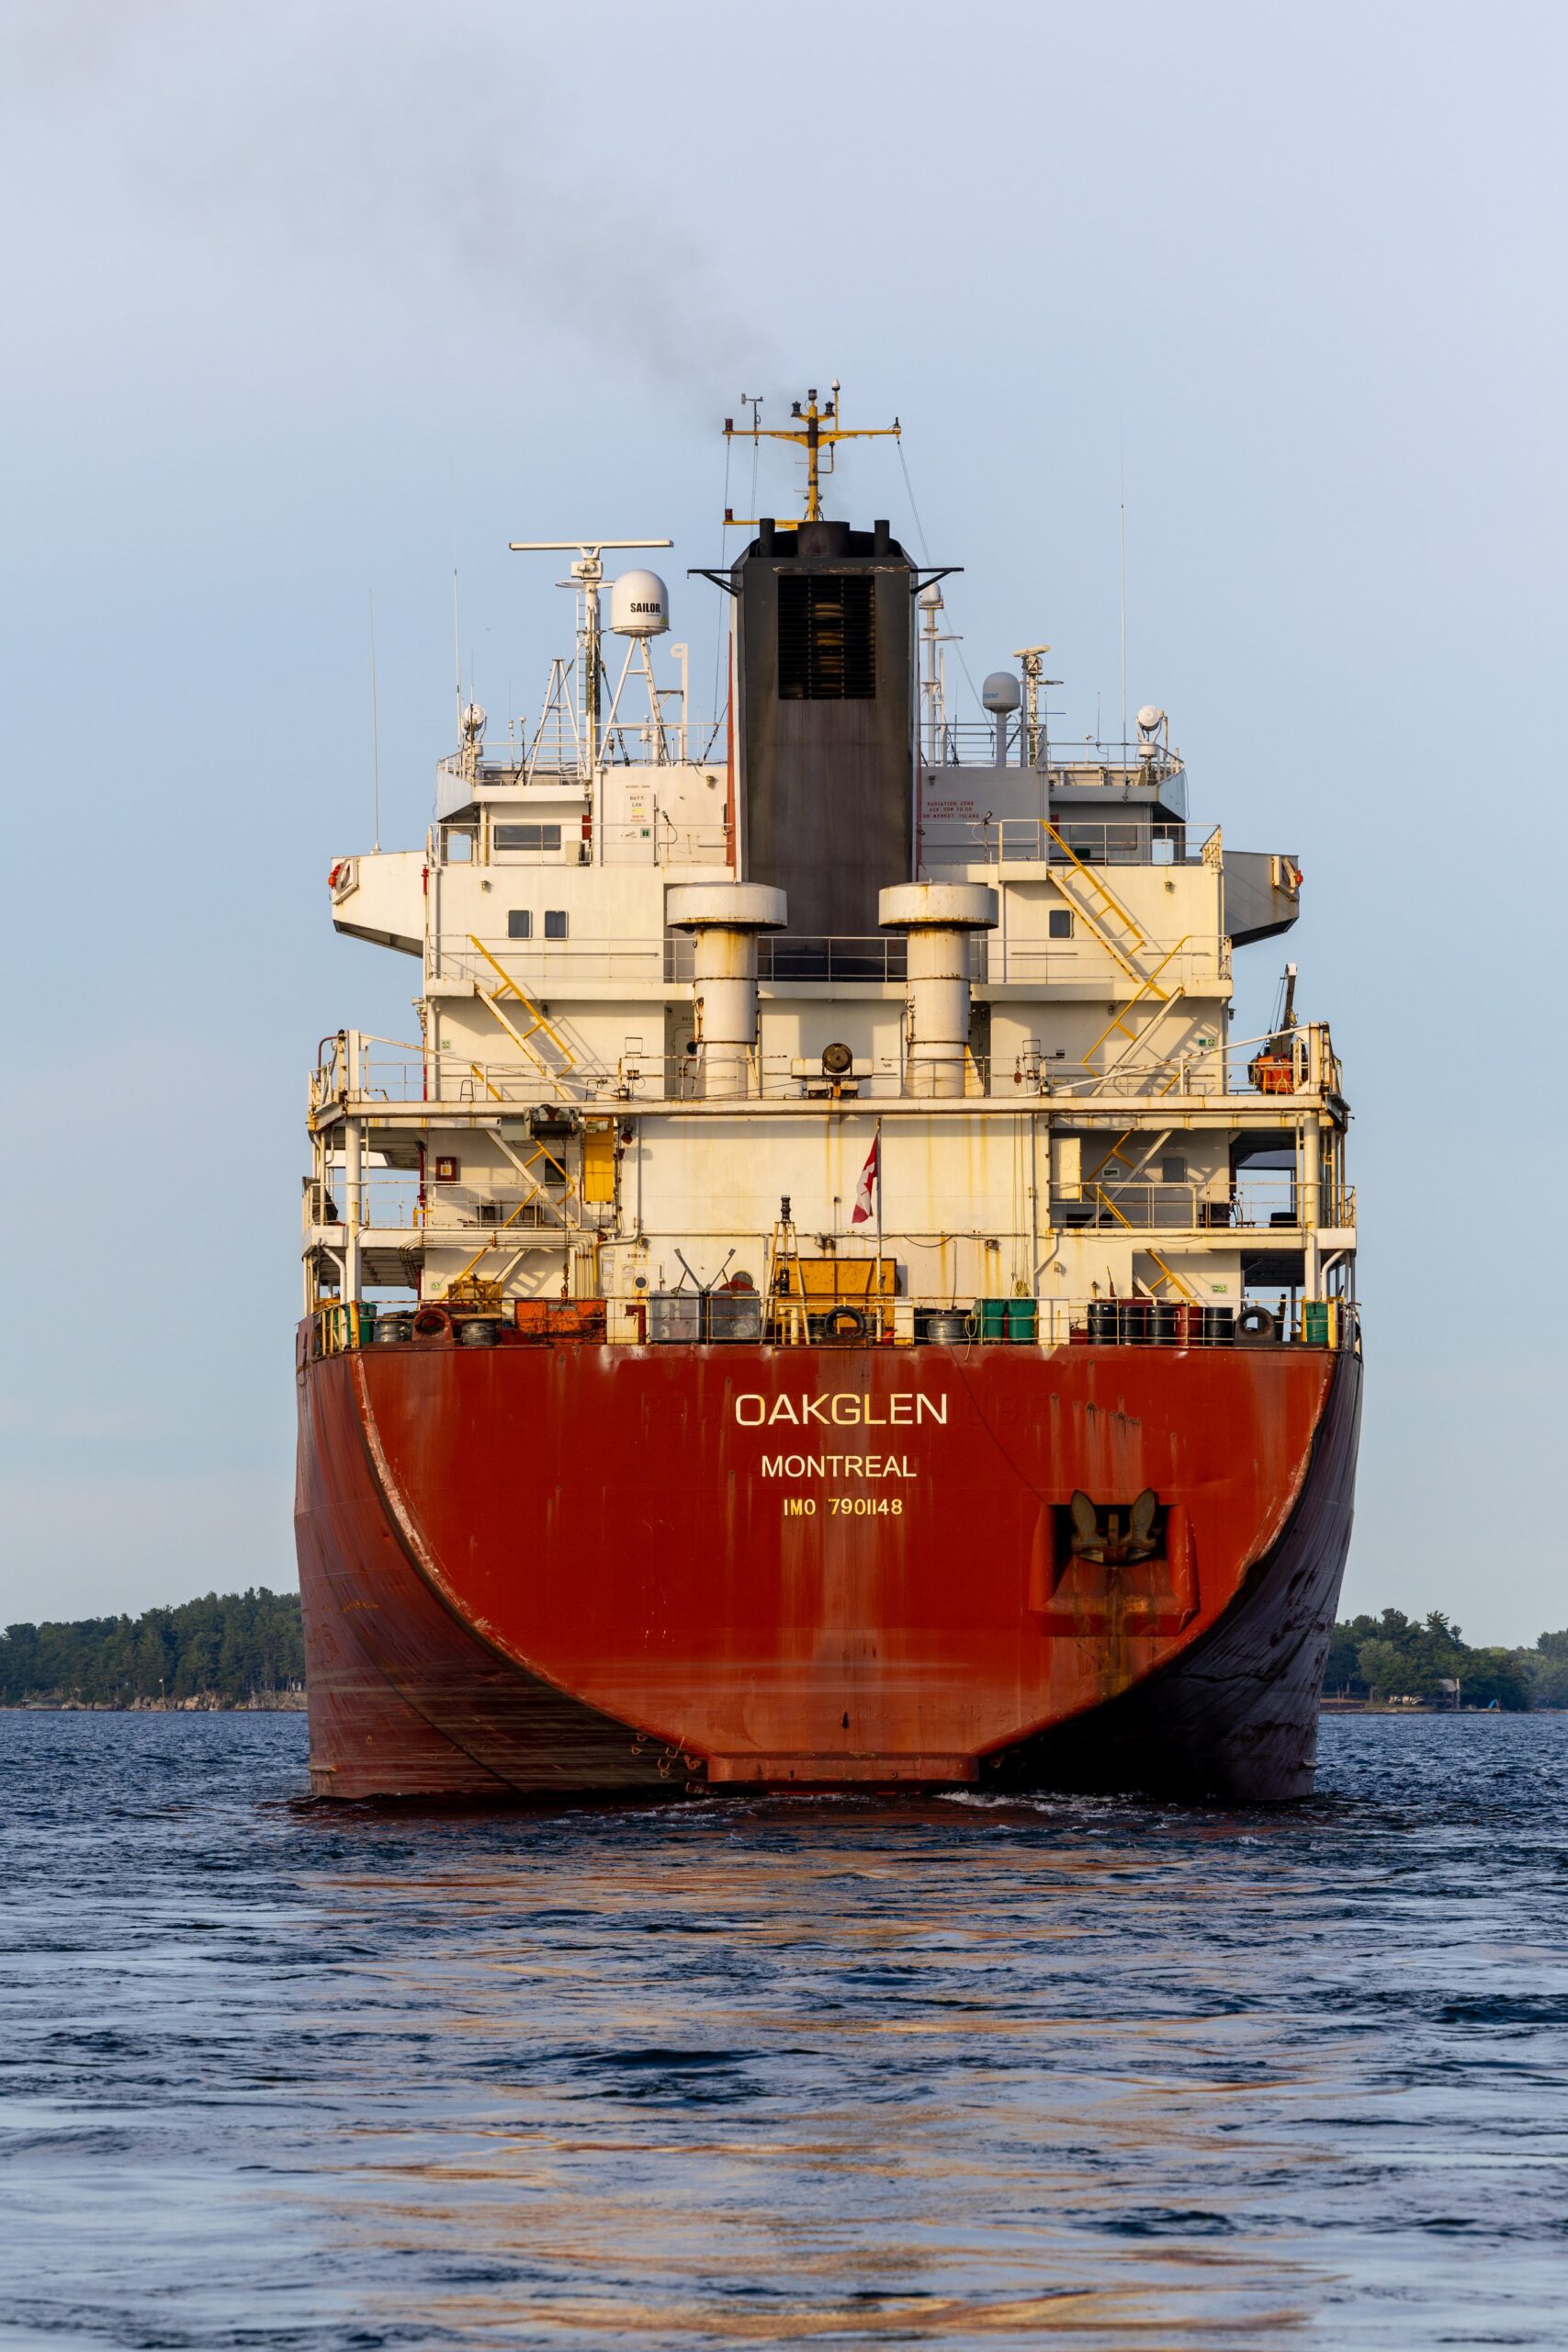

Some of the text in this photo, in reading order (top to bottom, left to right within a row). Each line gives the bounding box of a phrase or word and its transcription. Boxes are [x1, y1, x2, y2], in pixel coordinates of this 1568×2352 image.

[630, 603, 660, 613] SAILOR
[734, 1392, 947, 1426] OAKGLEN
[761, 1455, 917, 1478] MONTREAL
[784, 1498, 903, 1516] IMO 7901148
